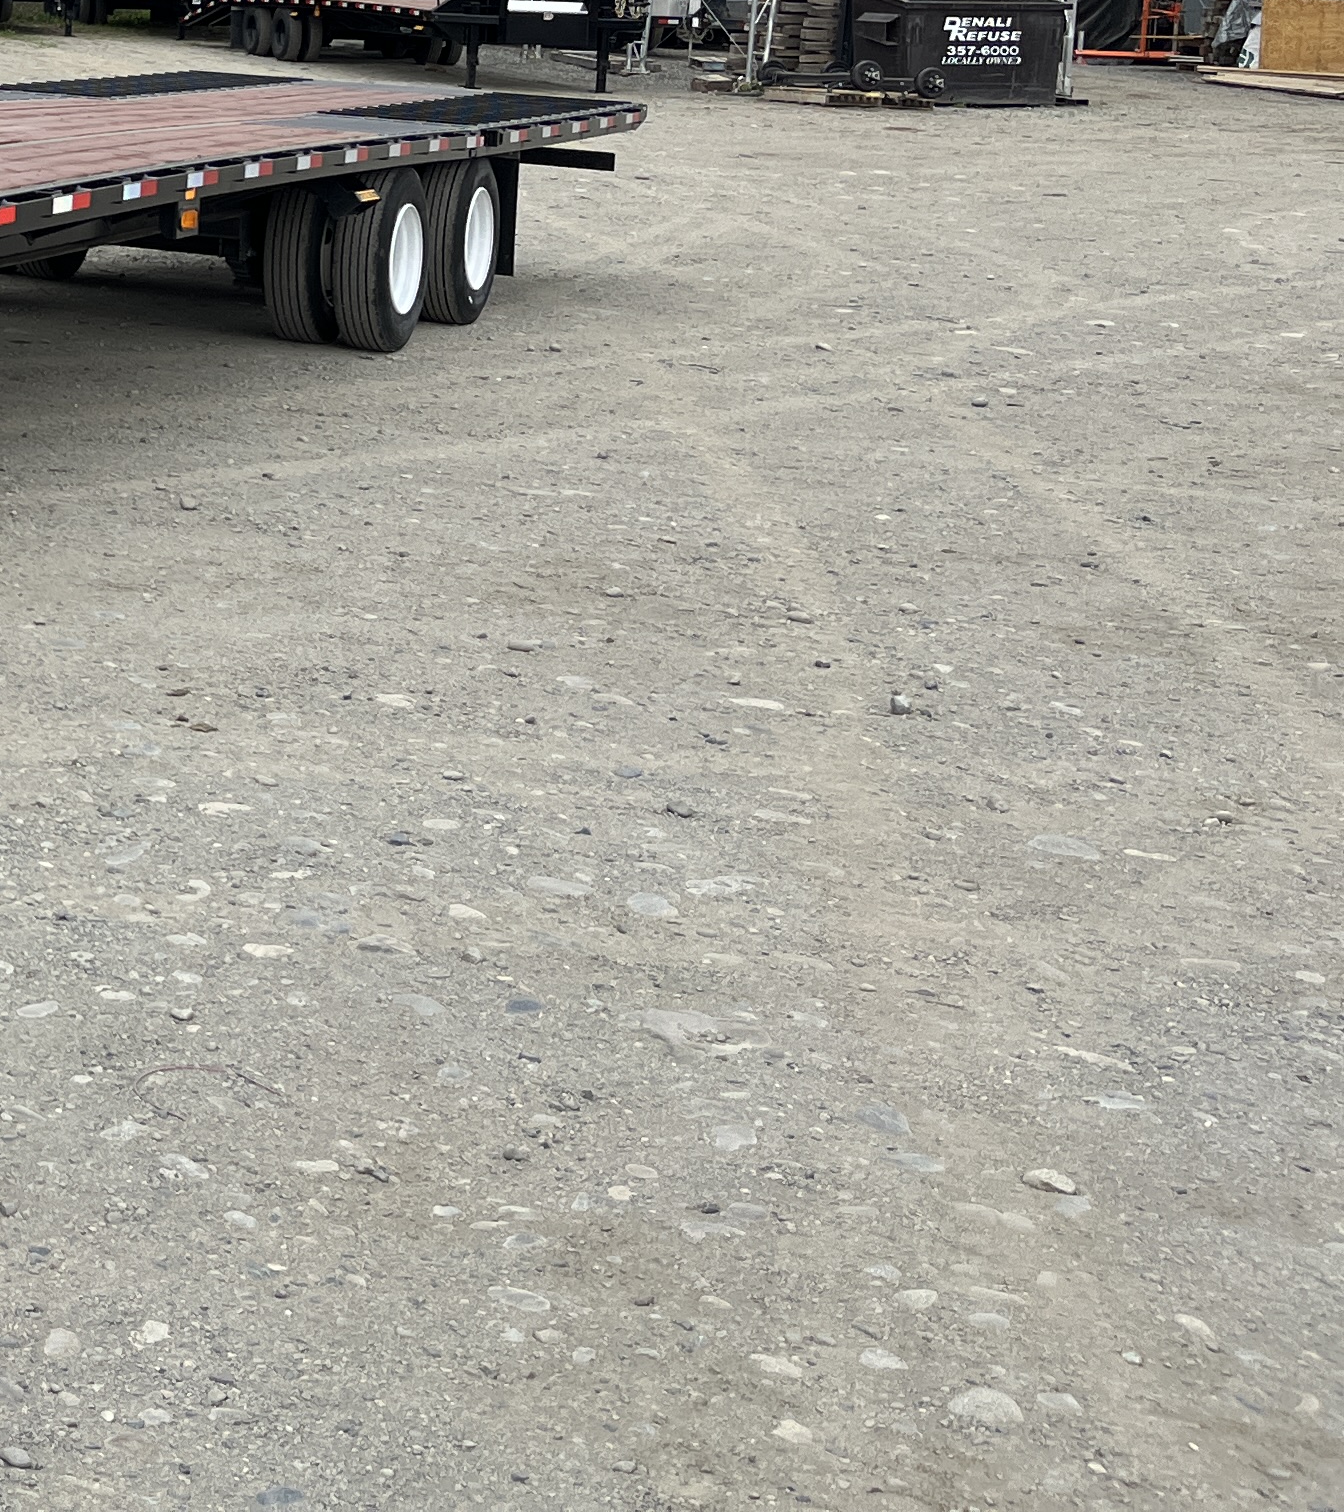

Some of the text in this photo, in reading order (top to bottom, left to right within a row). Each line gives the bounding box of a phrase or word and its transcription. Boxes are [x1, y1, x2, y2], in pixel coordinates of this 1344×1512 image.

[944, 16, 1012, 30] DENALI
[949, 28, 1022, 41] REFUSE
[946, 46, 1019, 55] 357-6000
[941, 56, 1022, 65] LOCALLY OWNED
